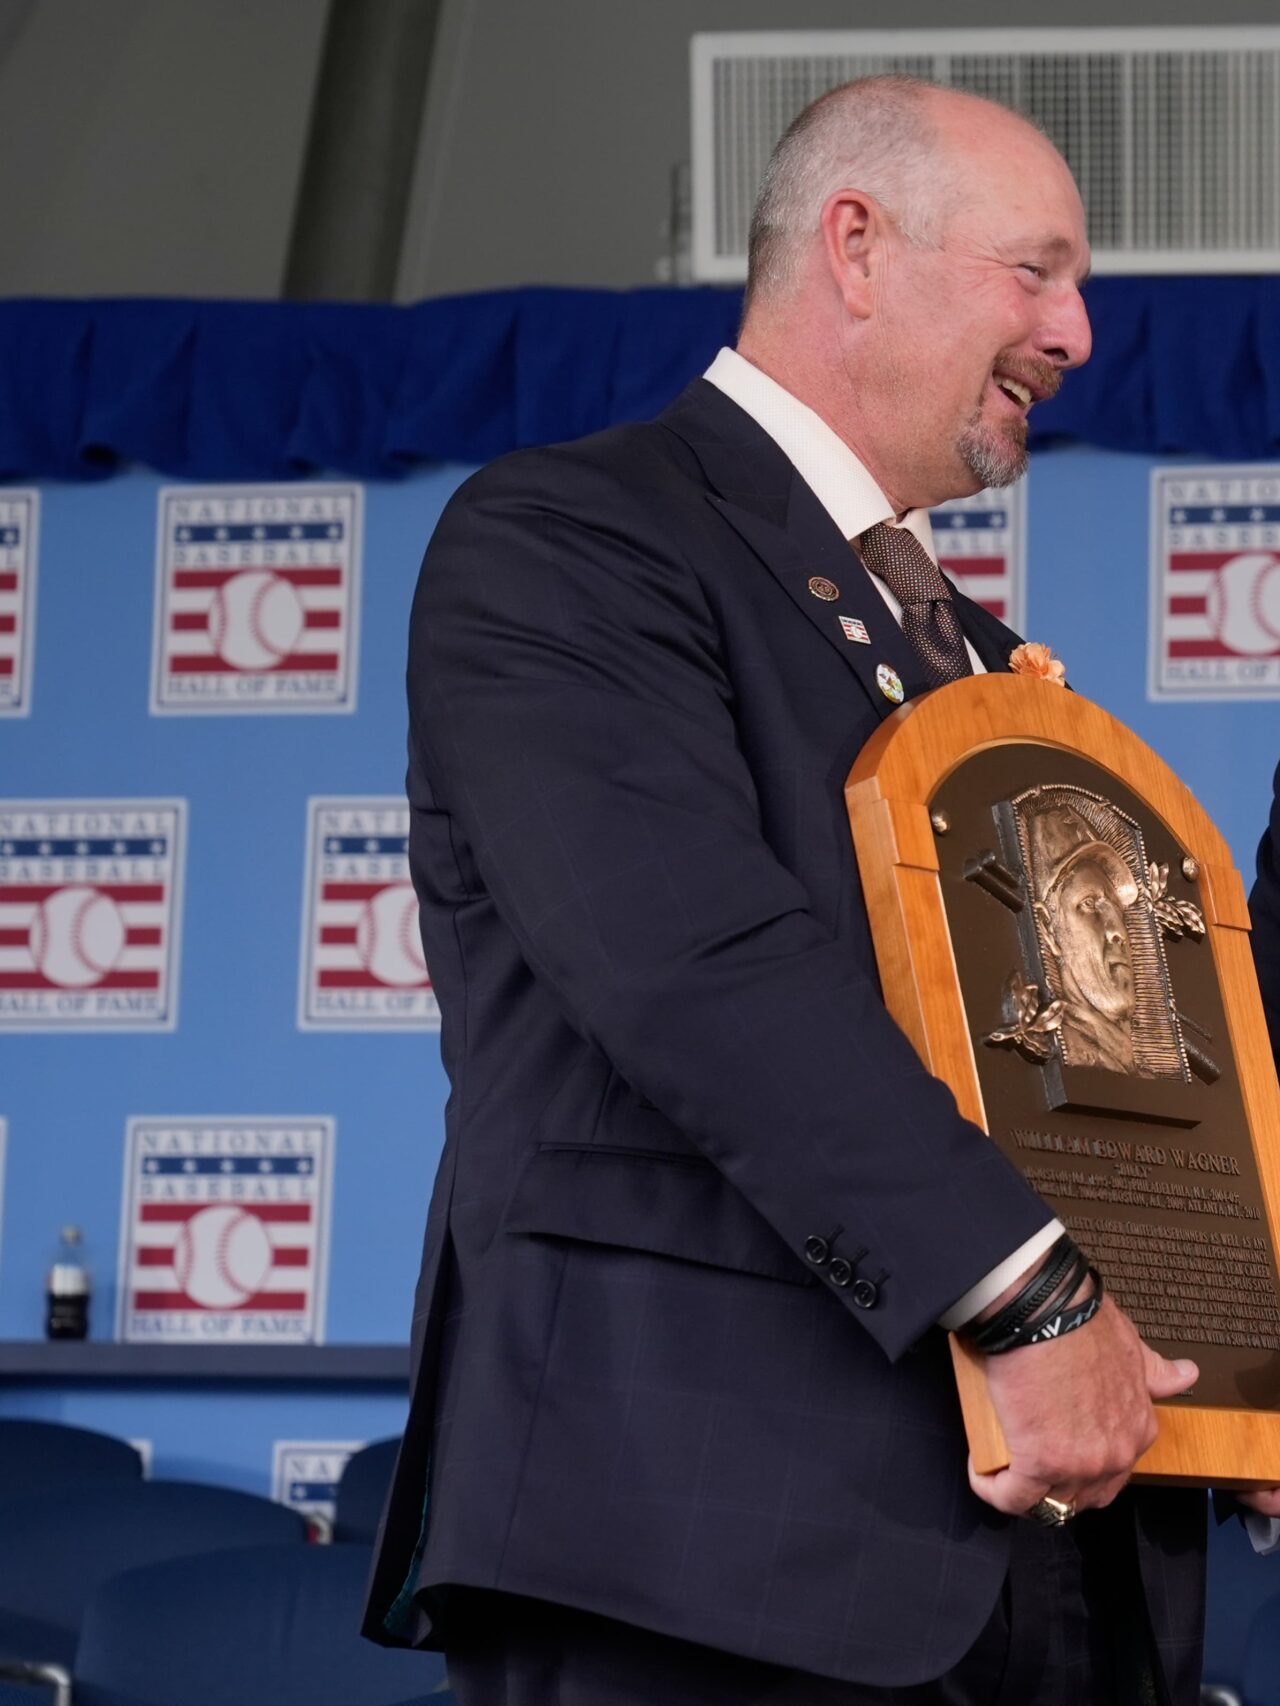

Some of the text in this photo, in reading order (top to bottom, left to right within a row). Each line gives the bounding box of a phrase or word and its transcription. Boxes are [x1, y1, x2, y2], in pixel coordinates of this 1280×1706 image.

[175, 498, 345, 518] NATIONAL
[174, 547, 343, 564] BASEBALL
[1168, 663, 1229, 680] HALL
[1237, 663, 1267, 680] OF
[168, 677, 337, 695] HALL OF FAME
[57, 995, 87, 1012] OF
[100, 994, 157, 1011] FAME
[316, 993, 374, 1011] HALL
[386, 993, 416, 1010] OF
[142, 1133, 314, 1151] NATIONAL
[1168, 1148, 1241, 1175] WAGNER
[141, 1179, 311, 1197] BASEBALL
[131, 1316, 306, 1334] HALL OF FAME
